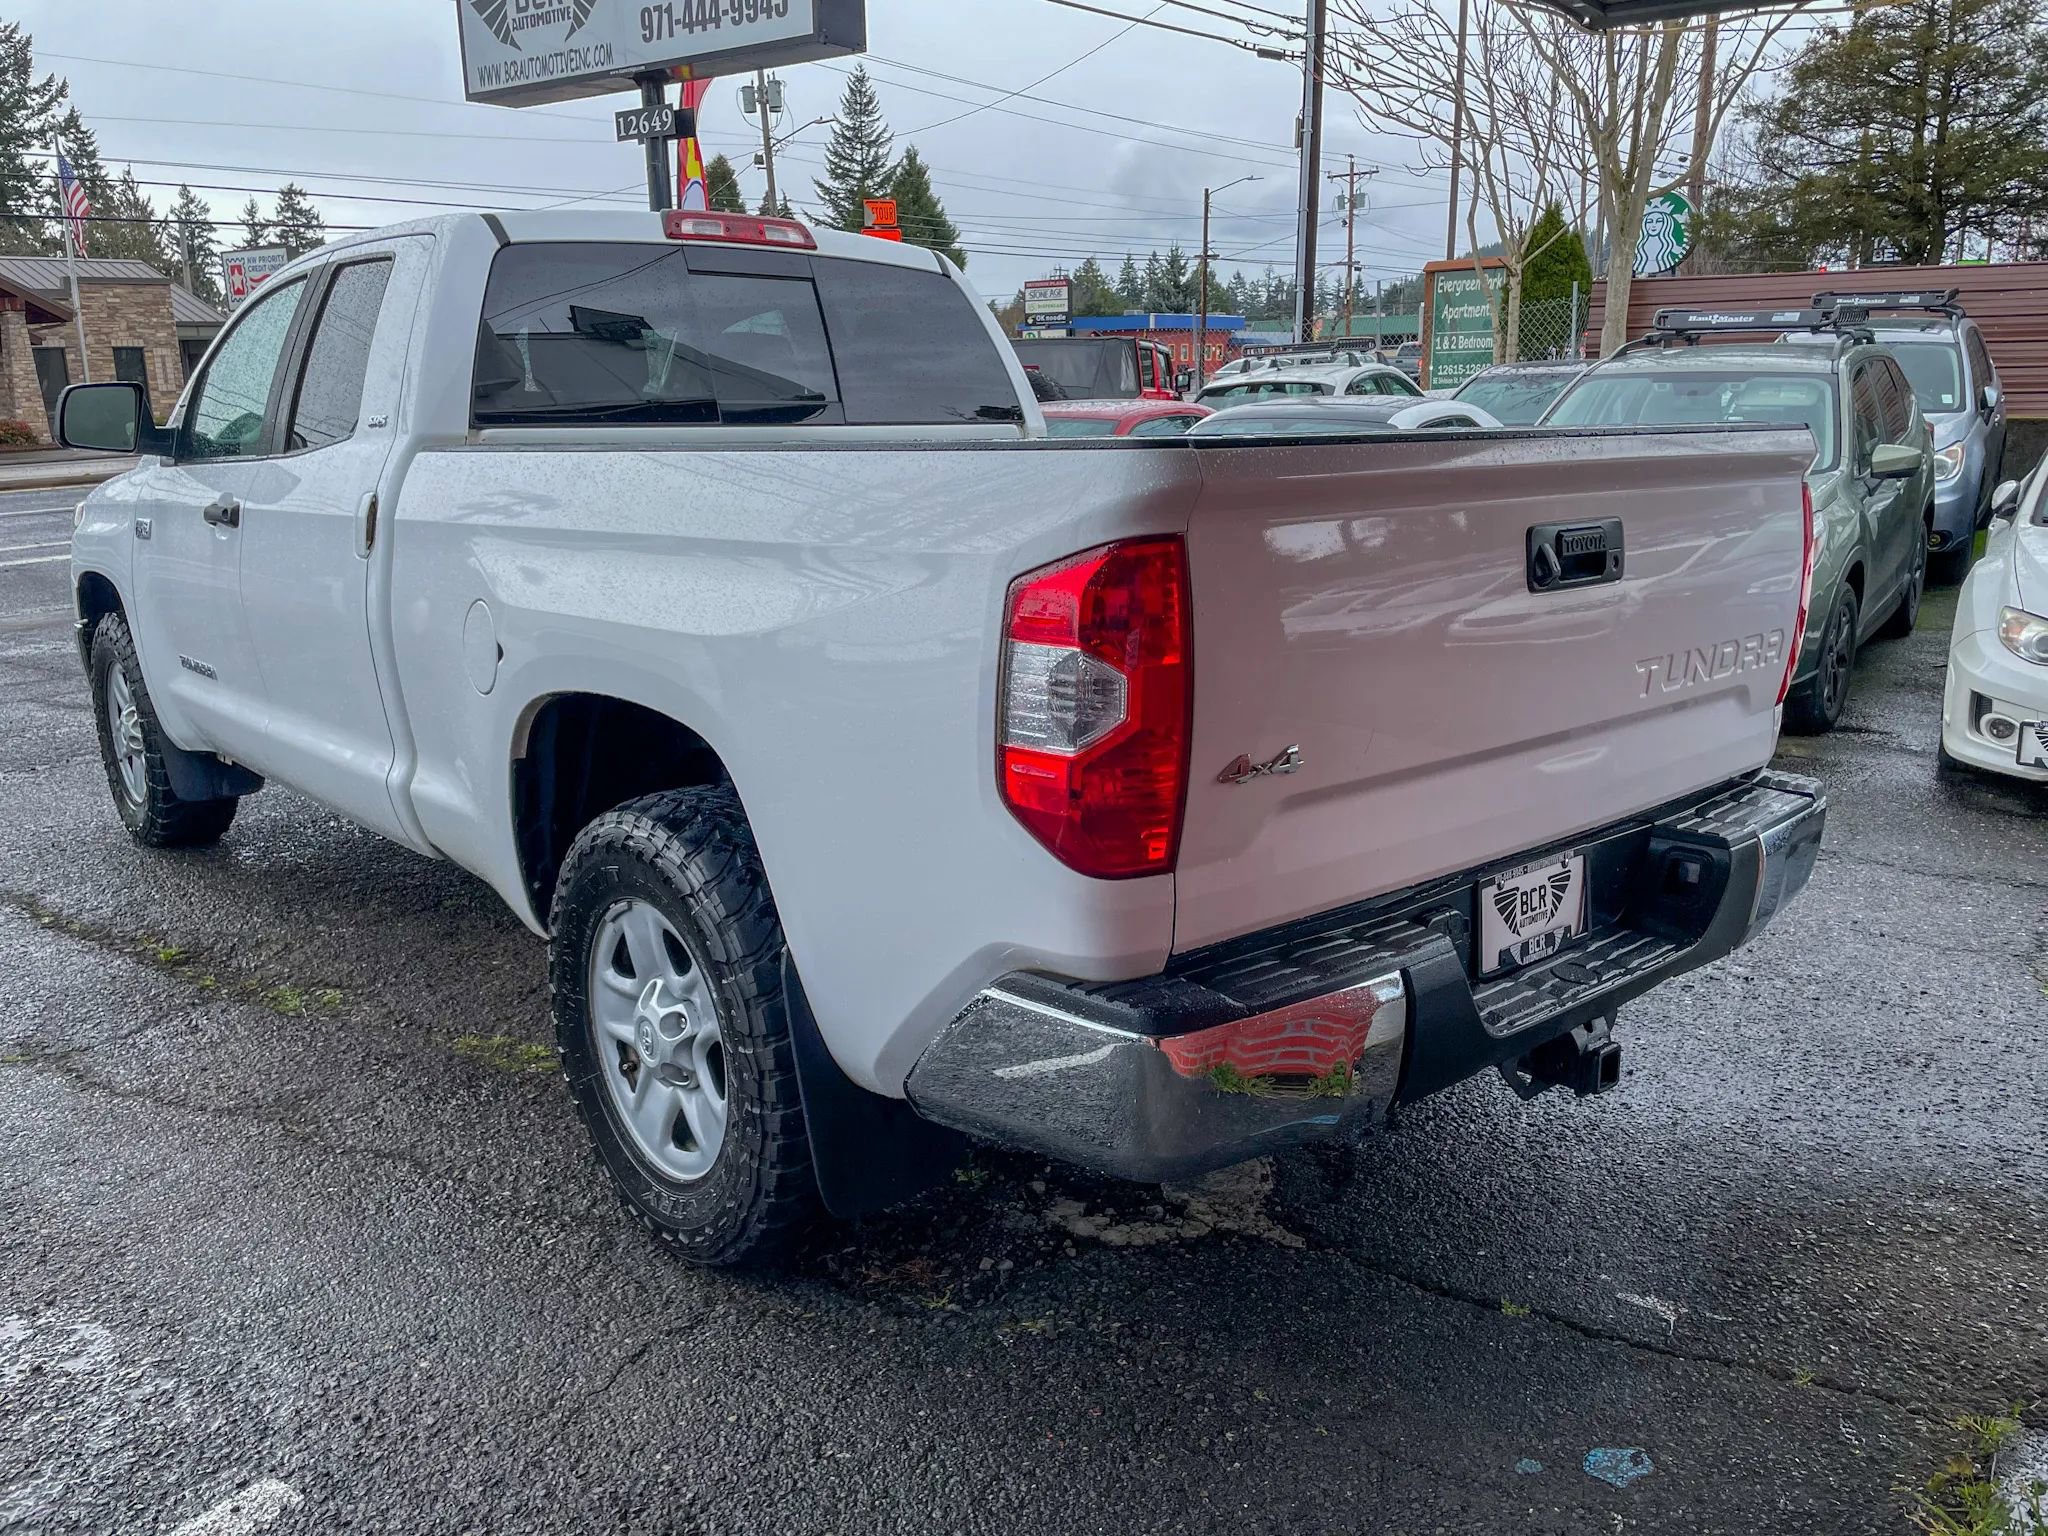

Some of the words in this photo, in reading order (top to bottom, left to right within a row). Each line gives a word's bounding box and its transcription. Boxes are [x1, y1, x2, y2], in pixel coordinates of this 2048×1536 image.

[512, 6, 572, 32] AUTOMOTIVE
[478, 42, 614, 88] WWW.BCRAUTOMOTIVEINC.COM
[617, 108, 673, 137] 12649
[248, 264, 267, 272] CREDIT
[258, 255, 285, 263] PRIORITY
[1437, 276, 1481, 298] Evergreen
[1441, 303, 1492, 324] Apartment
[1435, 336, 1441, 350] 1
[1442, 335, 1450, 350] &
[1451, 335, 1457, 350] 2
[1458, 335, 1493, 349] Bedroom
[1564, 534, 1606, 553] TOYOTA
[1634, 627, 1785, 698] TUNDRA
[1520, 884, 1547, 916] BCR
[1528, 934, 1546, 954] BCR
